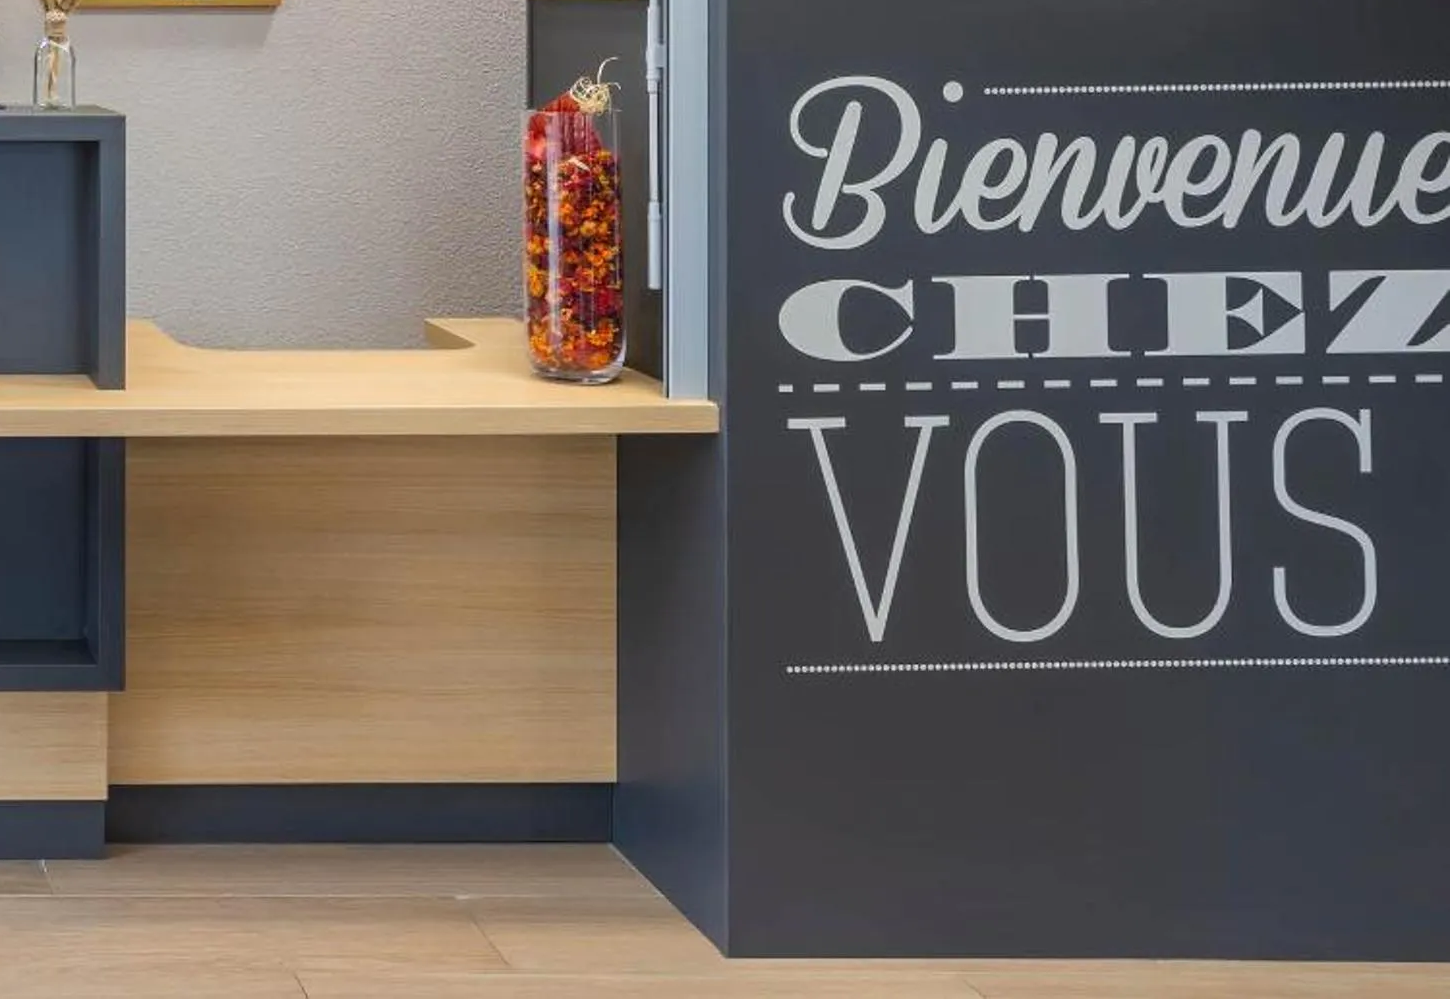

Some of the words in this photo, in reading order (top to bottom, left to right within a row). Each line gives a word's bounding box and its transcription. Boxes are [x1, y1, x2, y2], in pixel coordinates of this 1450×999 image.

[781, 74, 1450, 250] Bienvenue
[777, 269, 1450, 363] CHEZ
[786, 407, 1377, 643] VOUS
